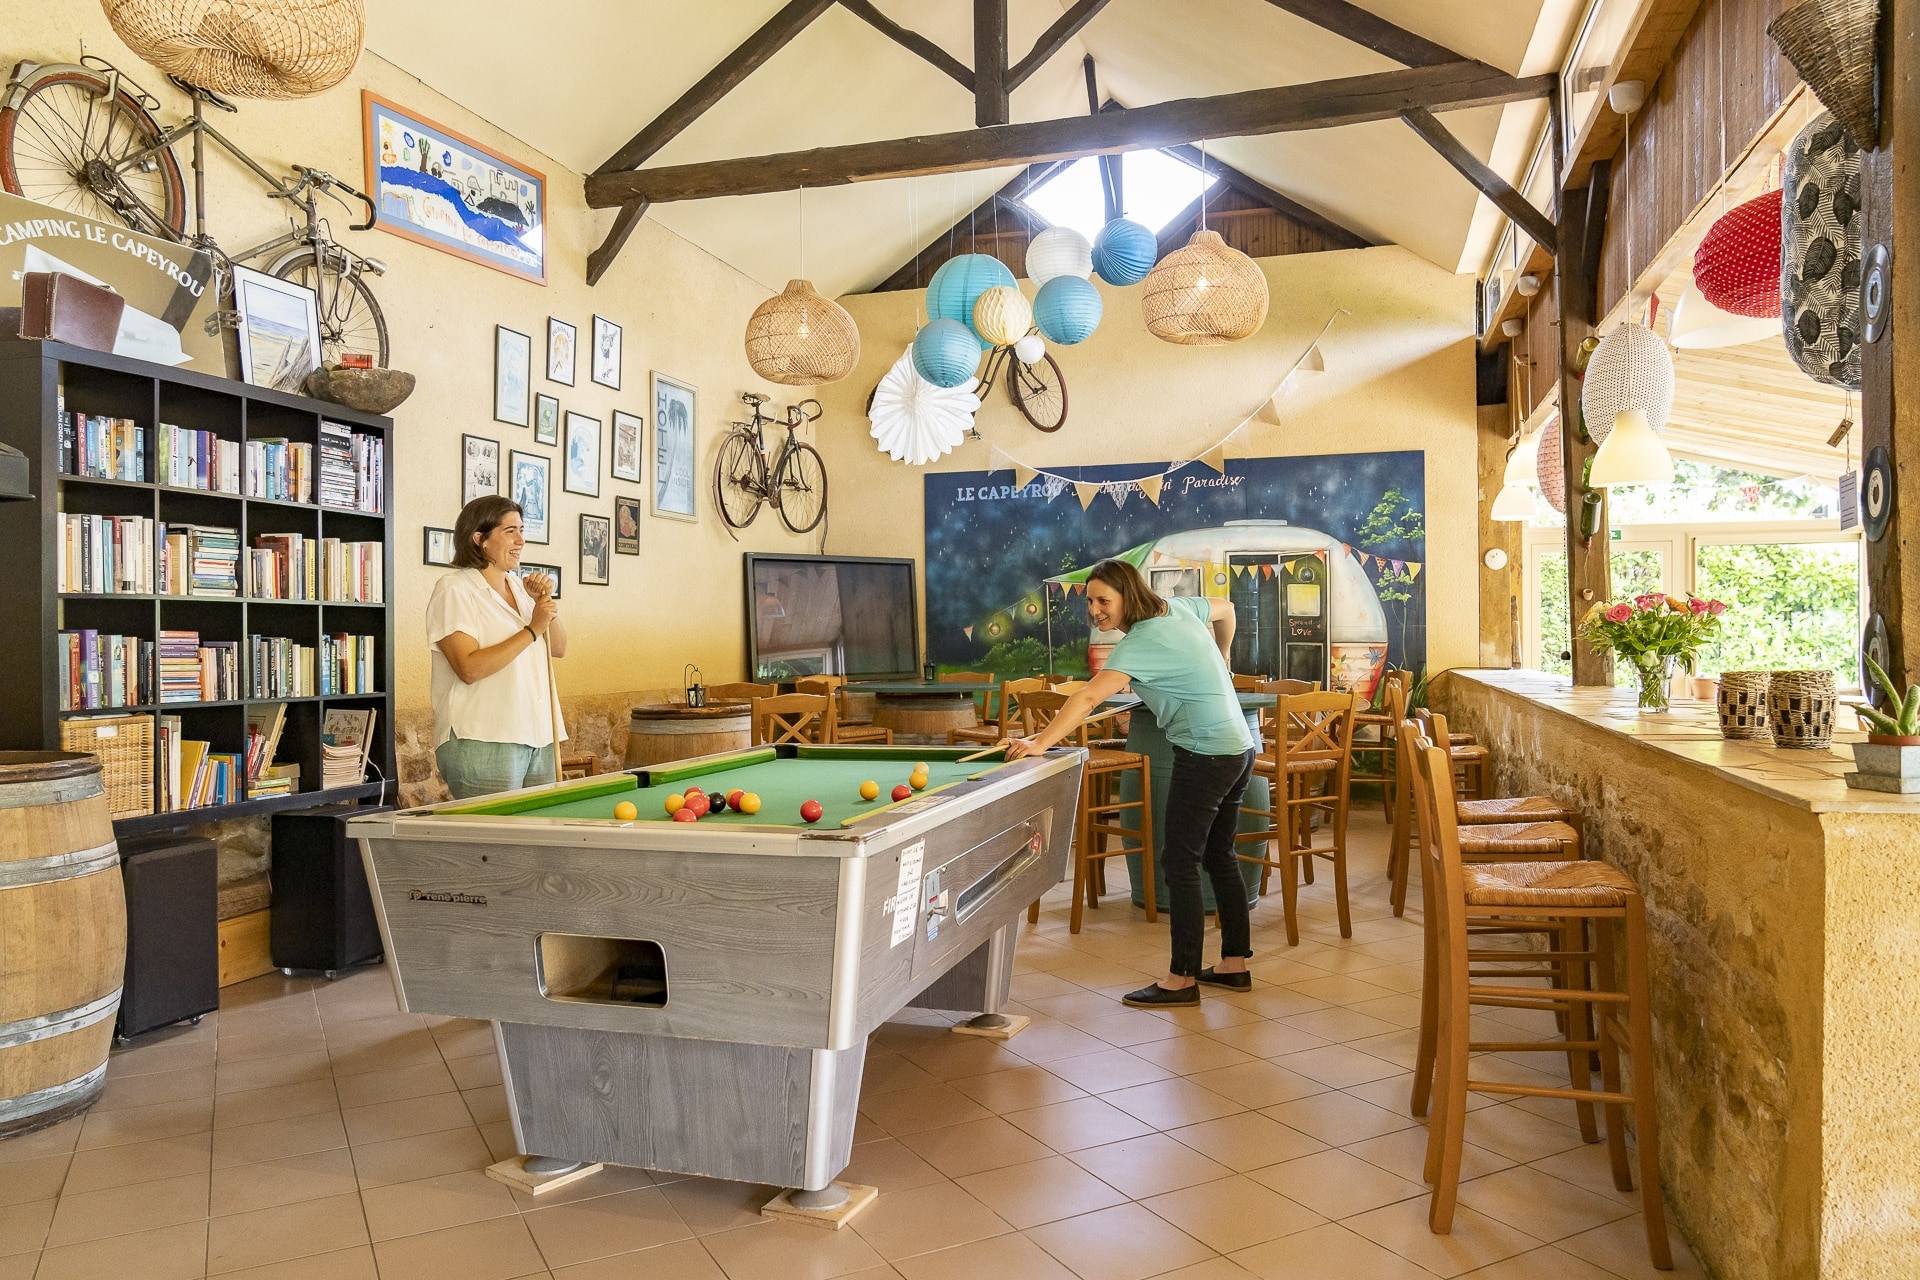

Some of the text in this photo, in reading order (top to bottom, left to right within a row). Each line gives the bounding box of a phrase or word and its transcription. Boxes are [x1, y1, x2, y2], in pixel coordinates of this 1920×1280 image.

[0, 219, 205, 297] CAMPING LE CAPEYROU
[657, 391, 667, 485] HOTEL
[675, 467, 690, 479] COOL
[957, 483, 1062, 502] LE CAPEYRO
[1182, 474, 1245, 495] Paradise
[1289, 618, 1313, 627] Spread
[453, 892, 488, 905] pierre
